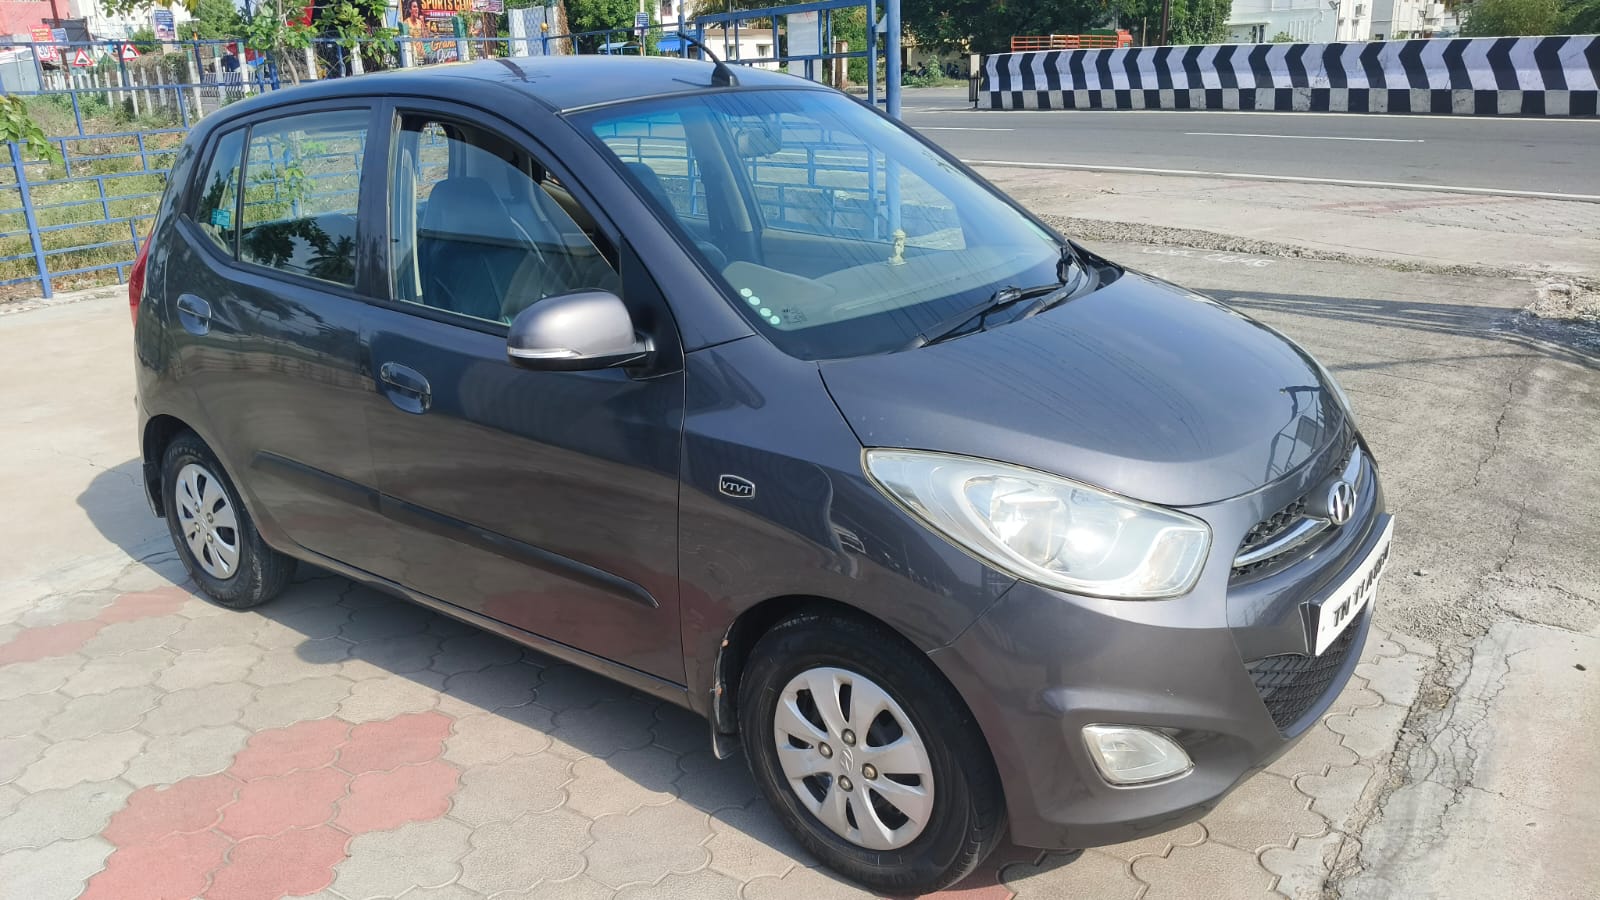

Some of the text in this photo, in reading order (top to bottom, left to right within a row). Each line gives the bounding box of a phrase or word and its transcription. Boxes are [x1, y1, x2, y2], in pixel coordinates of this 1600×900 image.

[421, 0, 453, 10] SPORTS
[722, 481, 751, 494] VTVT
[1333, 595, 1351, 627] TN
